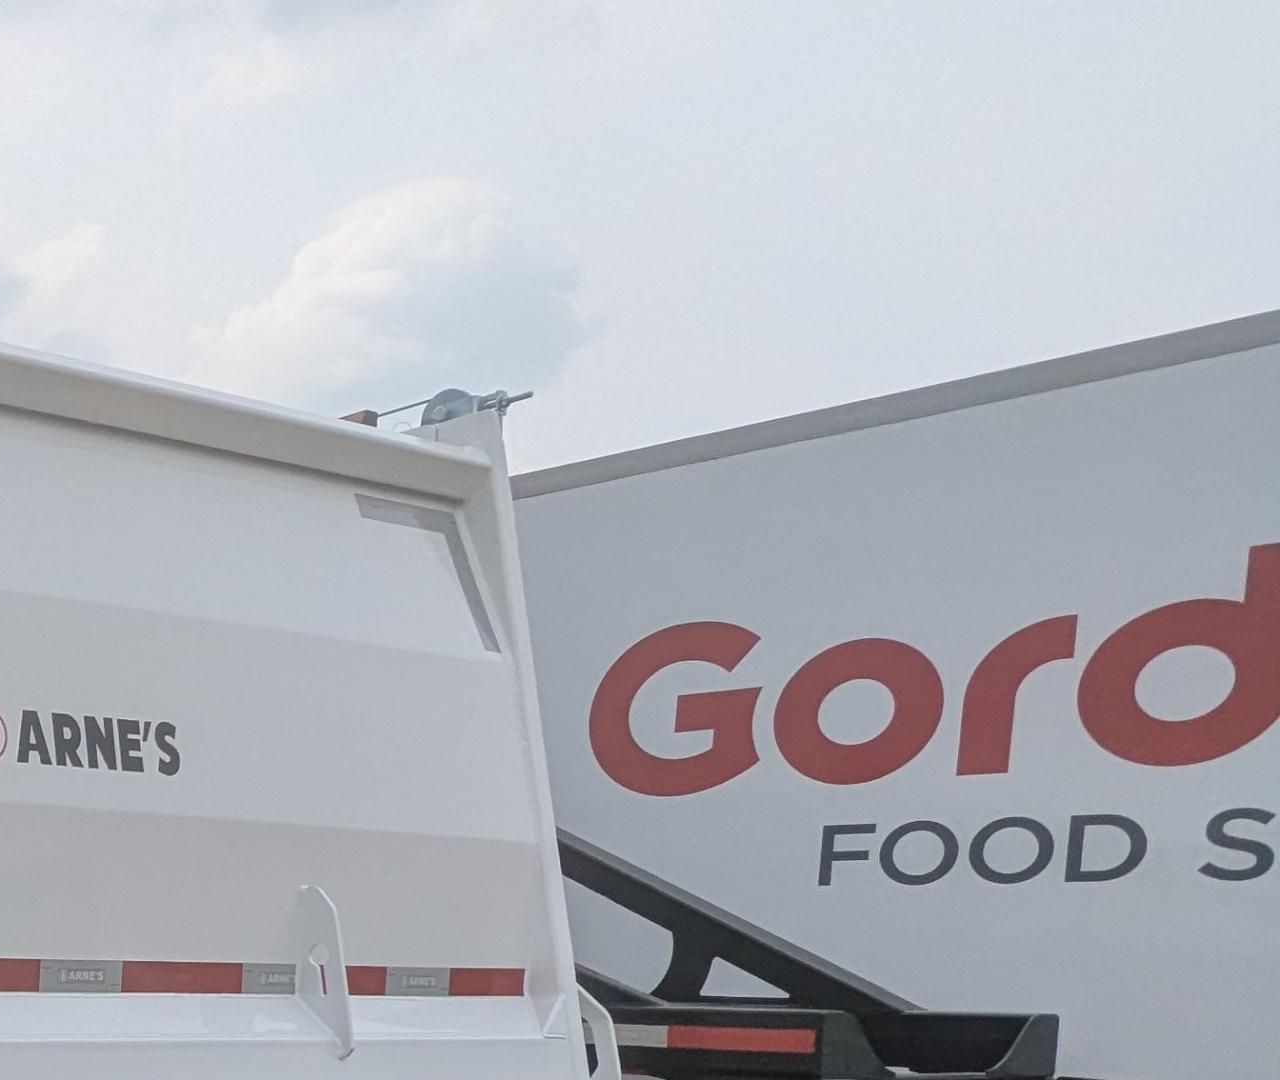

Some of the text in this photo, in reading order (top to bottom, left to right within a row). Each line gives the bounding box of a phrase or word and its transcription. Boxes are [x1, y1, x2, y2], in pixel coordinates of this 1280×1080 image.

[589, 543, 1280, 796] Gord
[17, 709, 181, 776] ARNE'S
[817, 814, 1148, 886] FOOD
[68, 970, 104, 981] ARNE'S
